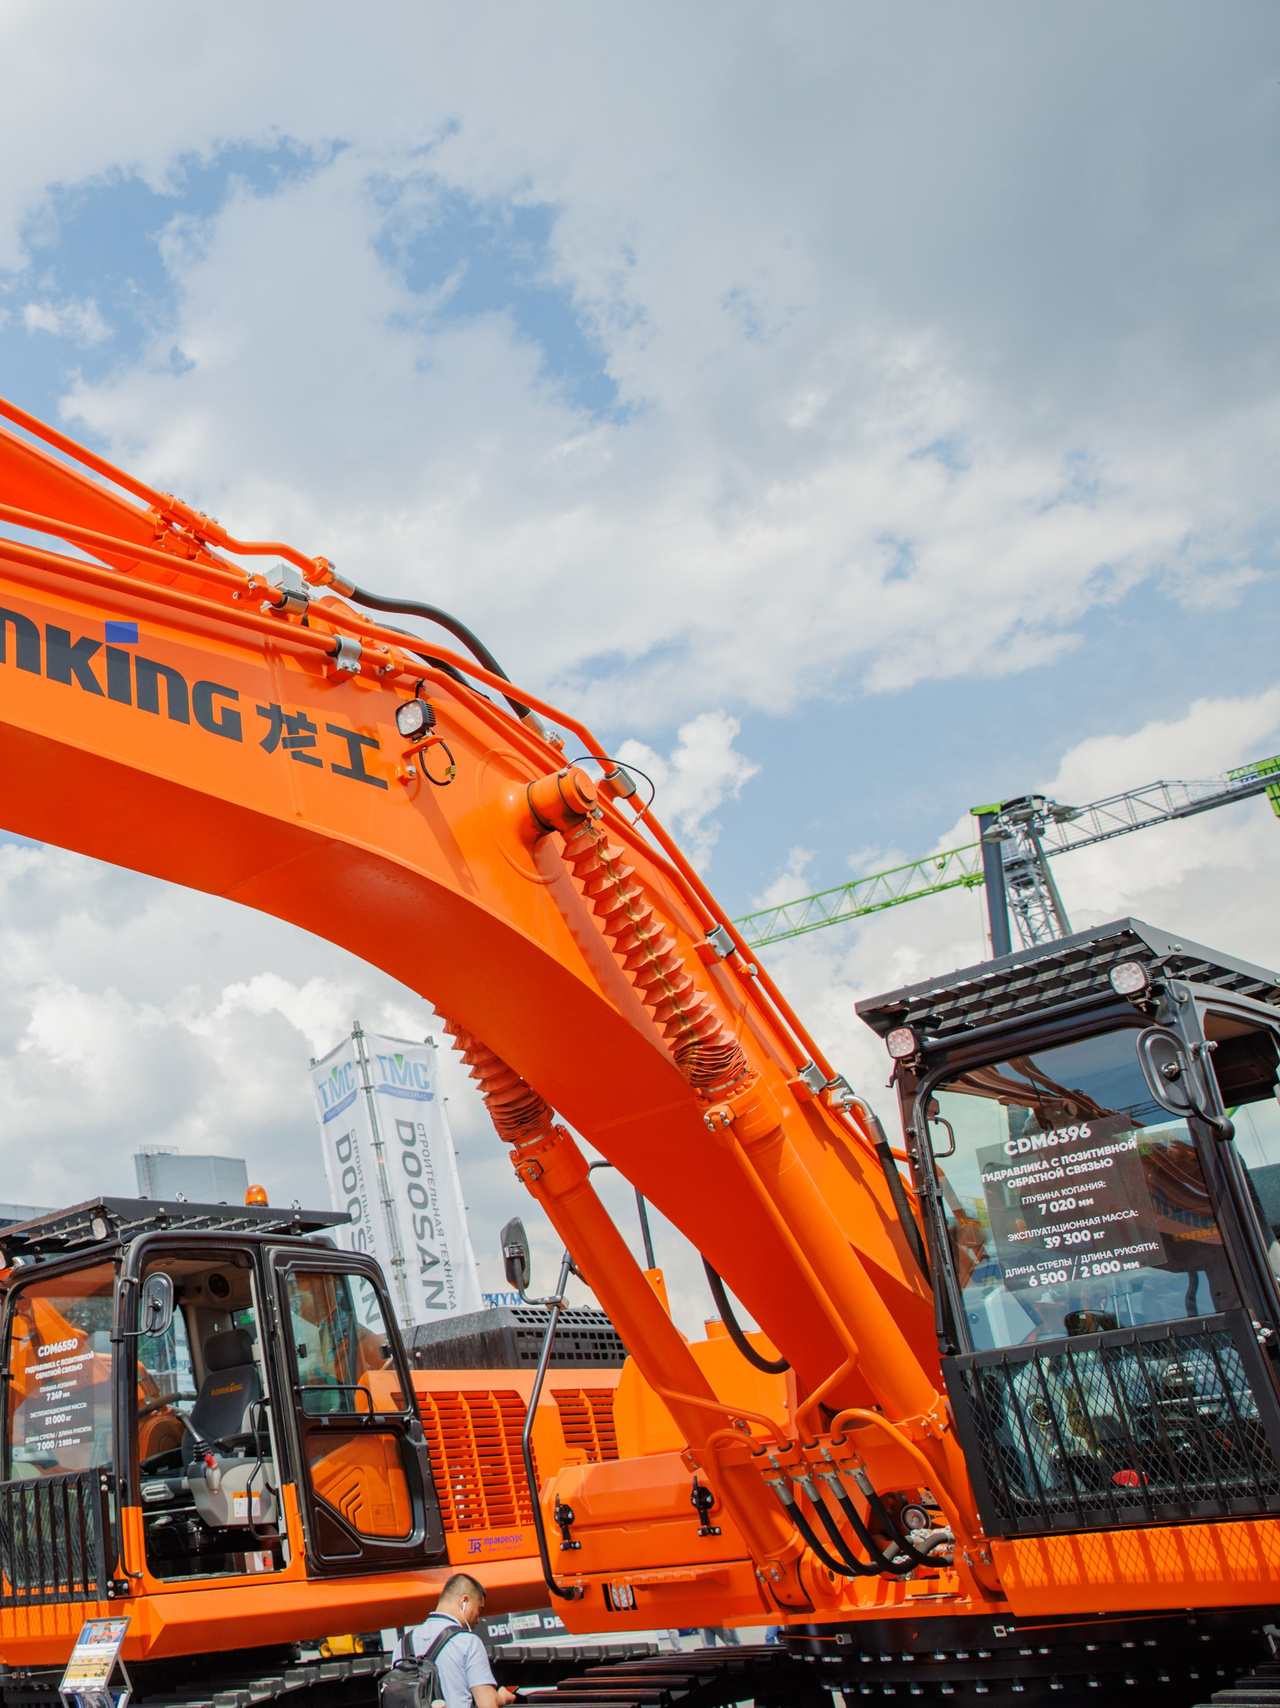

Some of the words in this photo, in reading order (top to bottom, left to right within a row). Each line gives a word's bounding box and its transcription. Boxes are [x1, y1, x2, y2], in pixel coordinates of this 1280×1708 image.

[256, 702, 389, 790] 龙工
[1004, 1123, 1092, 1156] CDM6396
[981, 1160, 1049, 1183] ГИДРАВЛИКА
[1051, 1157, 1060, 1167] С
[1061, 1137, 1138, 1165] ПОЗИТИВНОЙ
[1007, 1166, 1065, 1189] ОБРАТНОЙ
[1066, 1158, 1114, 1176] СВЯЗЬЮ
[350, 1128, 374, 1245] СТРОИТЕЛЬНАЯ
[1022, 1191, 1060, 1205] ГЛУБИНА
[1061, 1181, 1107, 1197] КОПАНИЯ:
[395, 1118, 448, 1310] DOOSAN
[417, 1122, 445, 1237] СТРОИТЕЛЬНАЯ
[439, 1241, 457, 1311] ТЕХНИКА
[1038, 1205, 1047, 1215] 7
[1050, 1198, 1076, 1213] 020
[1078, 1197, 1094, 1207] мм
[1007, 1217, 1100, 1242] ЭКСПЛУАТАЦИОННАЯ
[1102, 1210, 1139, 1222] МАССА:
[1044, 1236, 1061, 1249] 39
[1063, 1230, 1092, 1245] 300
[1093, 1231, 1106, 1240] кг
[1005, 1265, 1036, 1278] ДЛИНА
[1037, 1257, 1072, 1271] СТРЕЛЫ
[1080, 1250, 1113, 1264] ДЛИНА
[1115, 1242, 1159, 1257] РУКОЯТИ:
[1029, 1276, 1038, 1287] 6
[1040, 1270, 1067, 1285] 500
[1080, 1267, 1091, 1278] 2
[1093, 1261, 1121, 1276] 800
[1123, 1260, 1140, 1271] мм
[37, 1338, 78, 1358] CDM6550
